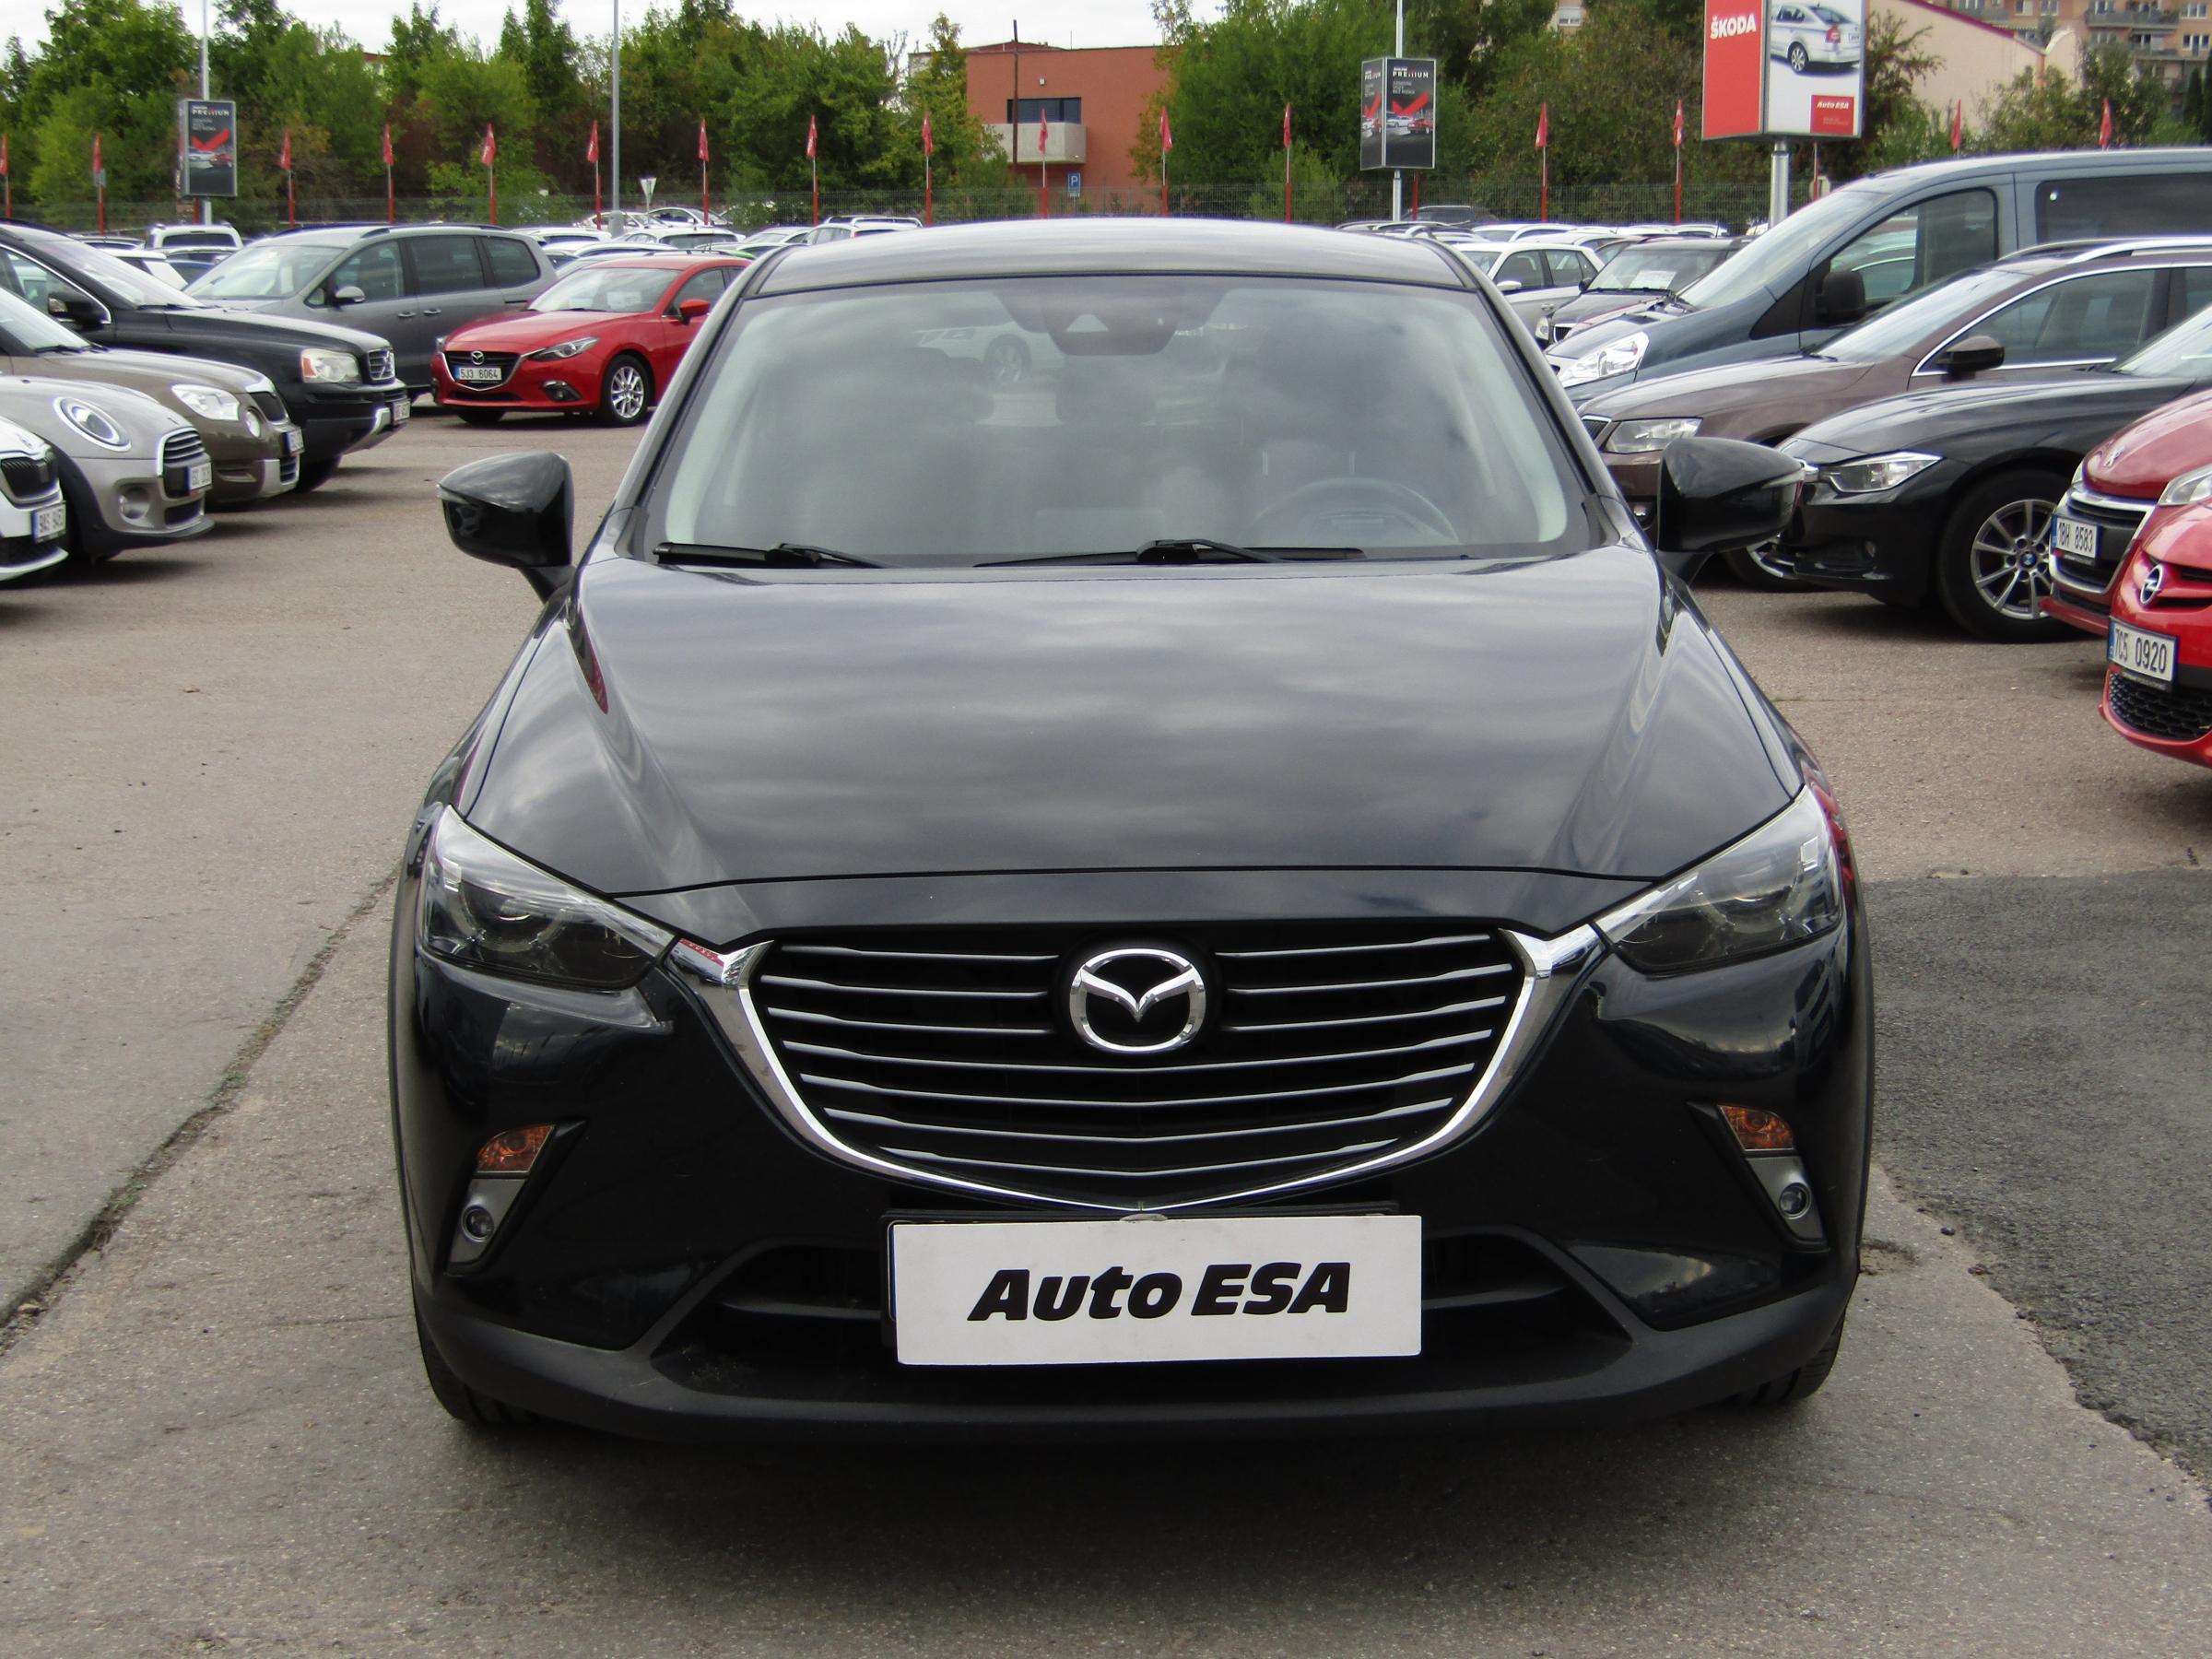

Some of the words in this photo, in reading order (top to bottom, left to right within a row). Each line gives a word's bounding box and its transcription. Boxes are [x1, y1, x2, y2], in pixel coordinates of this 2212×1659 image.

[1710, 15, 1757, 40] ŠKODA
[479, 369, 498, 379] 6064
[2075, 525, 2093, 552] 8583
[2135, 637, 2167, 674] 0920
[968, 1265, 1182, 1322] Auto
[1190, 1262, 1351, 1316] ESA
